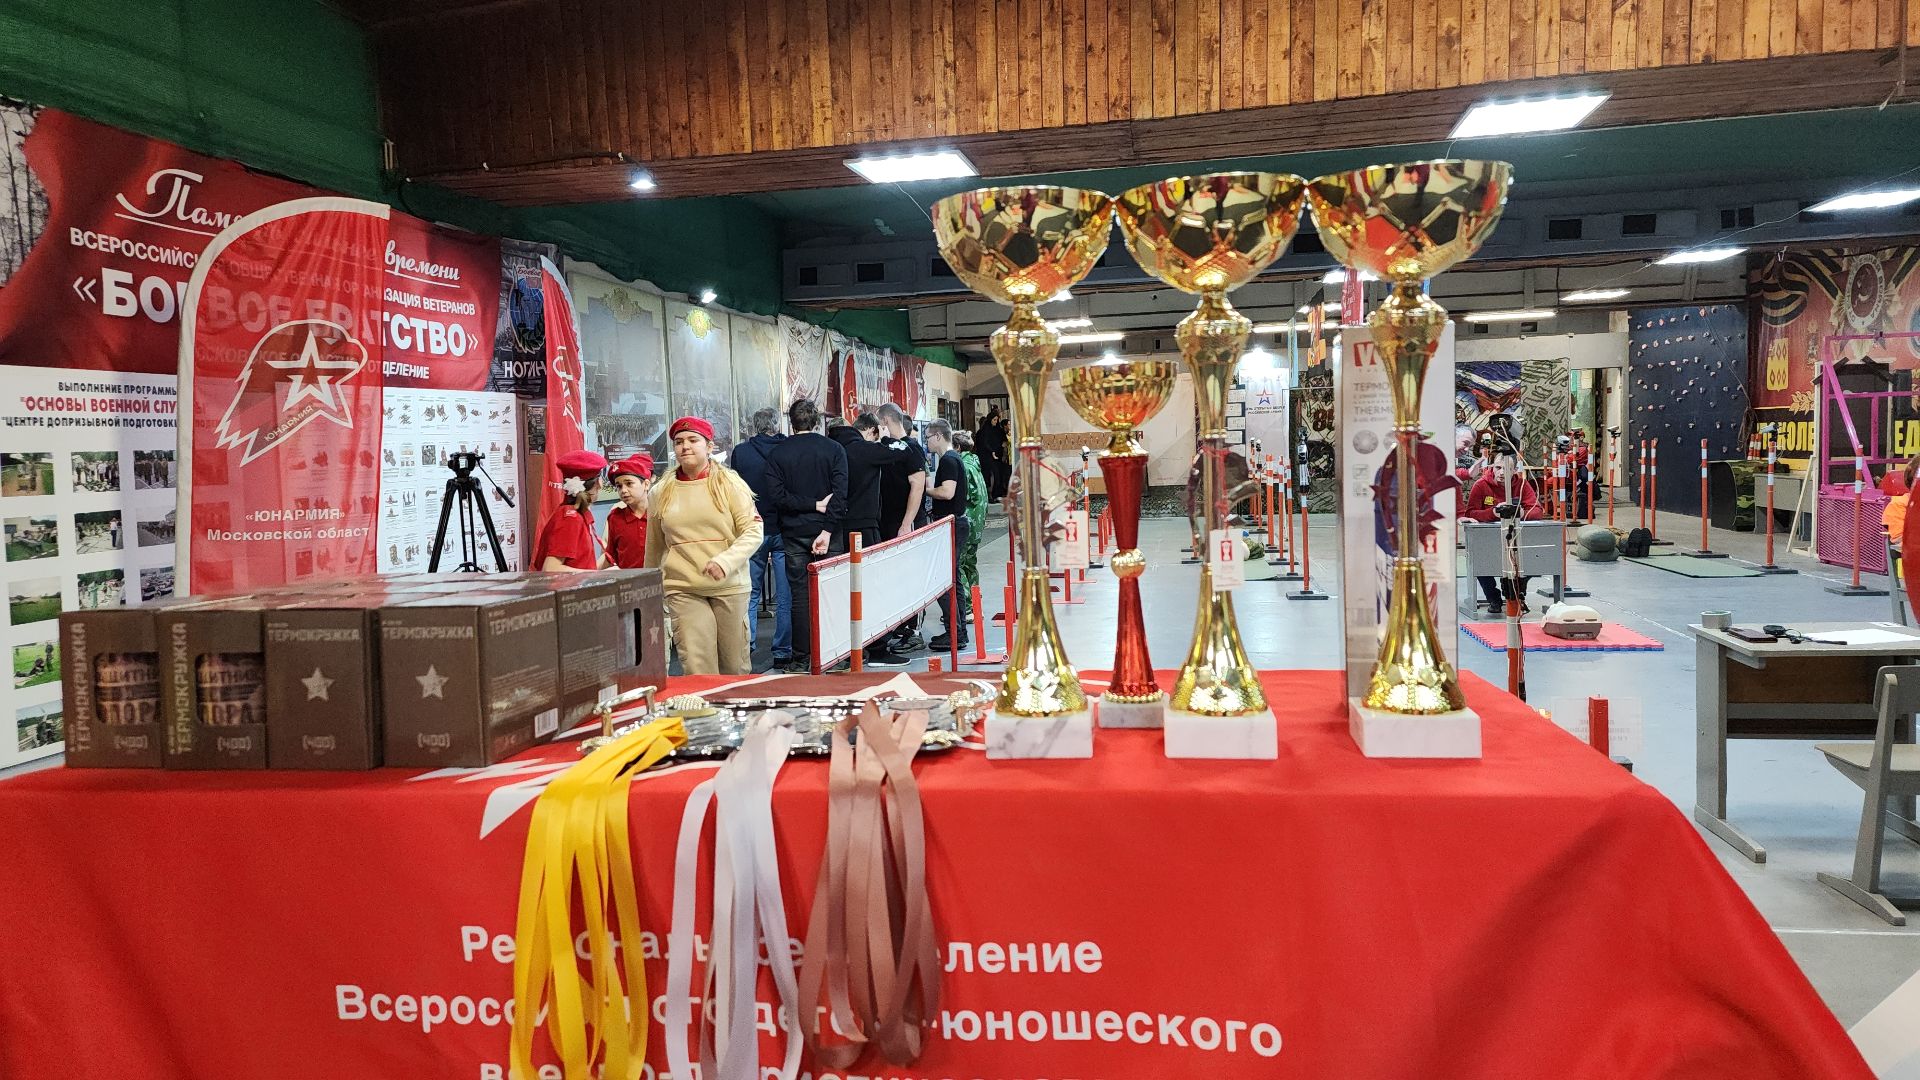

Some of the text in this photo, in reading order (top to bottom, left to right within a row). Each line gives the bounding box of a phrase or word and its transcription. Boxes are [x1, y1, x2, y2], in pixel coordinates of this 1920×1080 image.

[385, 240, 460, 281] времени
[423, 296, 475, 315] ВЕТЕРАНОВ
[58, 382, 122, 394] ВЫПОЛНЕНИЕ
[91, 397, 150, 413] ВОЕННОЙ
[47, 416, 120, 428] ДОПРИЗЫВНОЙ
[264, 405, 313, 442] ЮНАРМИЯ
[207, 527, 312, 542] Московской
[268, 628, 361, 642] ТЕРМОКРУЖКА
[382, 626, 474, 640] ТЕРМОКРУЖКА
[71, 622, 92, 751] ТЕРМОКРУЖКА
[172, 622, 192, 753] ТЕРМОКРУЖКА
